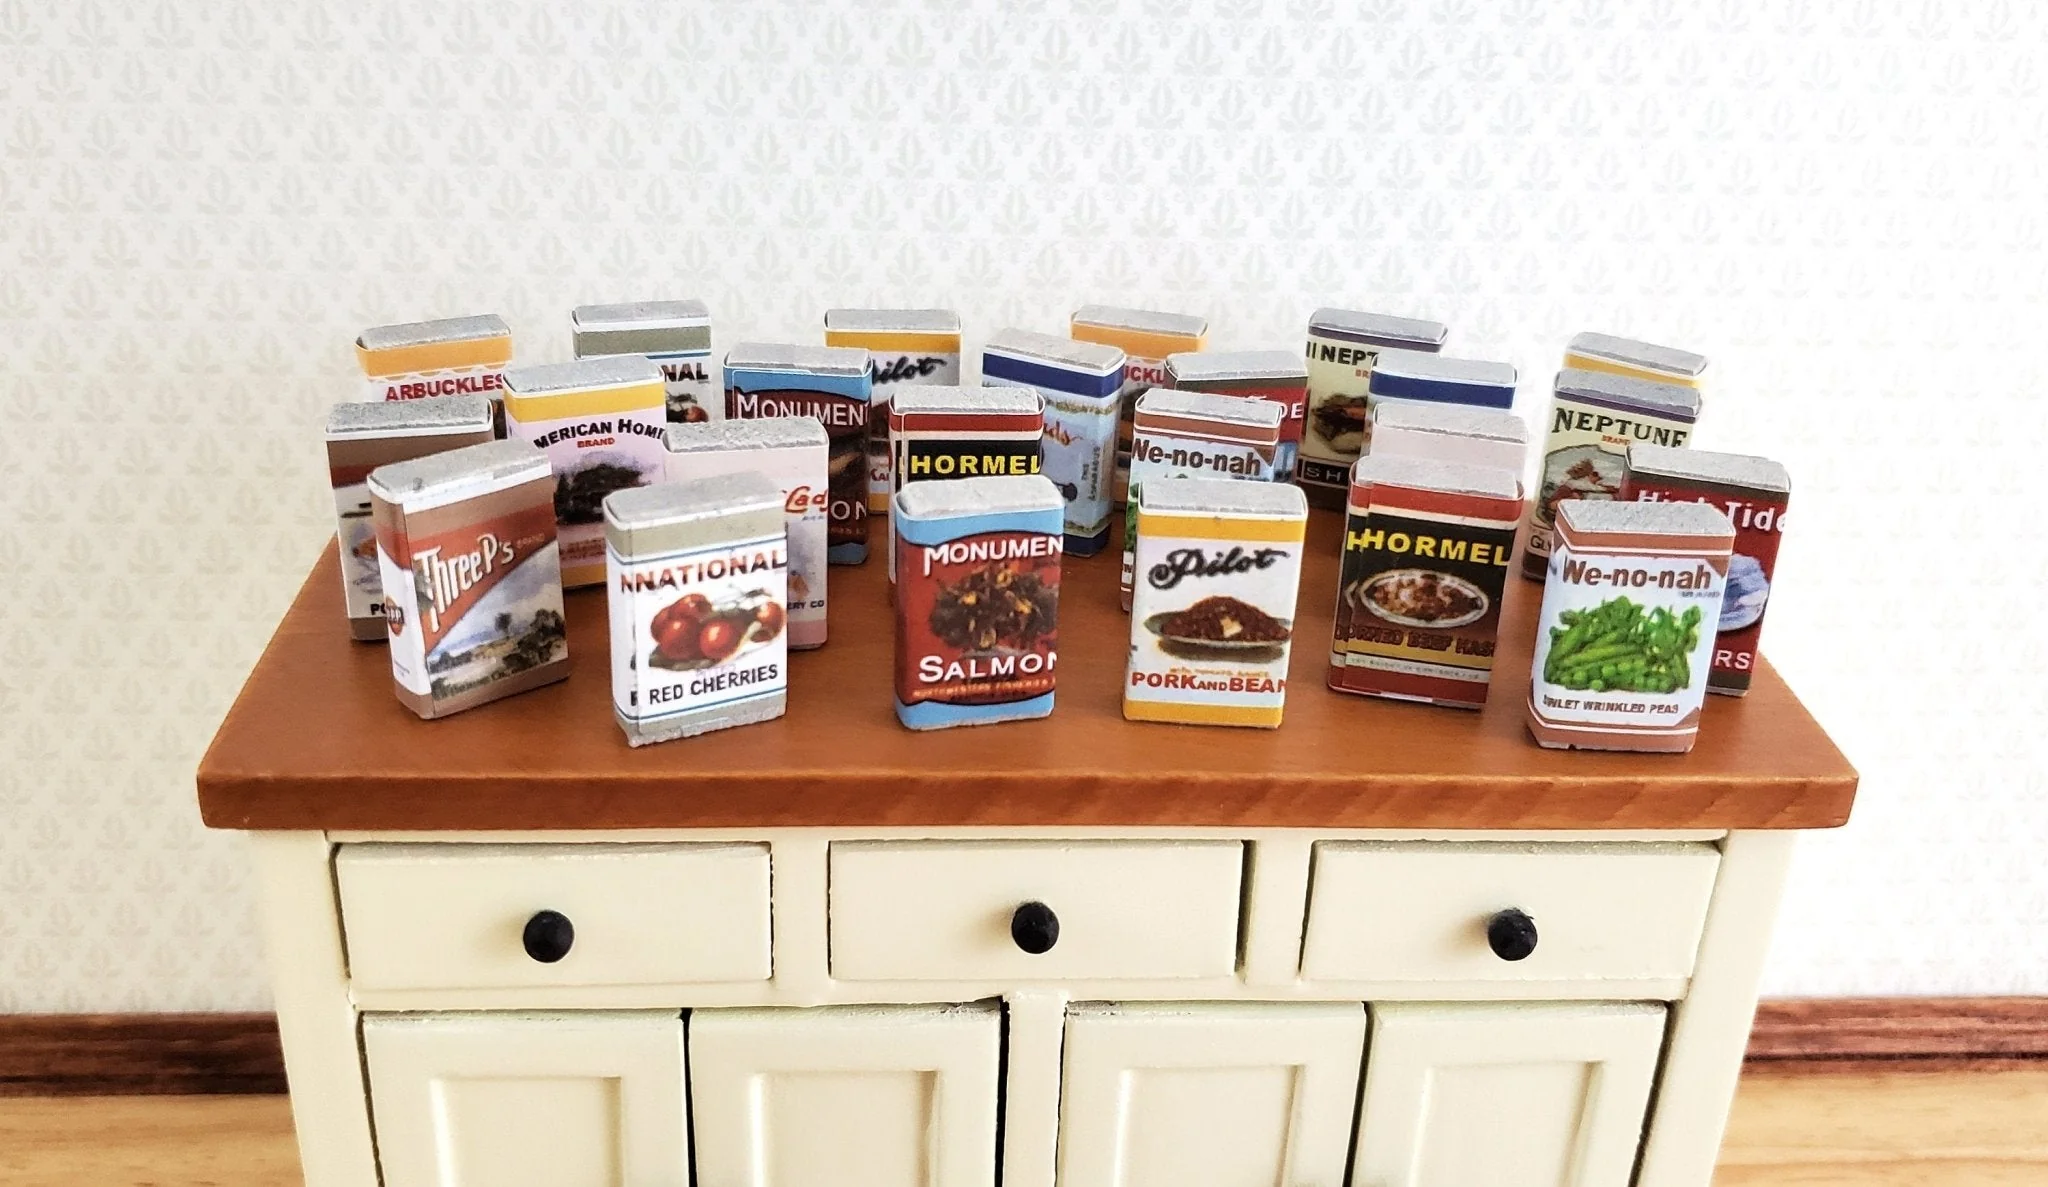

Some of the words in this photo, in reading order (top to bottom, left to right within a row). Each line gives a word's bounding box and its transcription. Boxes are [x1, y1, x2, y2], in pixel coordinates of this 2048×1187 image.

[385, 373, 503, 401] ARBUCKLES
[577, 437, 615, 448] BRAND
[911, 455, 1041, 475] HORMEL
[1148, 546, 1290, 590] Pilot
[1562, 556, 1712, 589] We-no-nah
[649, 684, 683, 705] RED
[690, 664, 778, 696] CHERRIES
[1583, 700, 1645, 714] WRINKLED
[1649, 703, 1679, 715] PEAS
